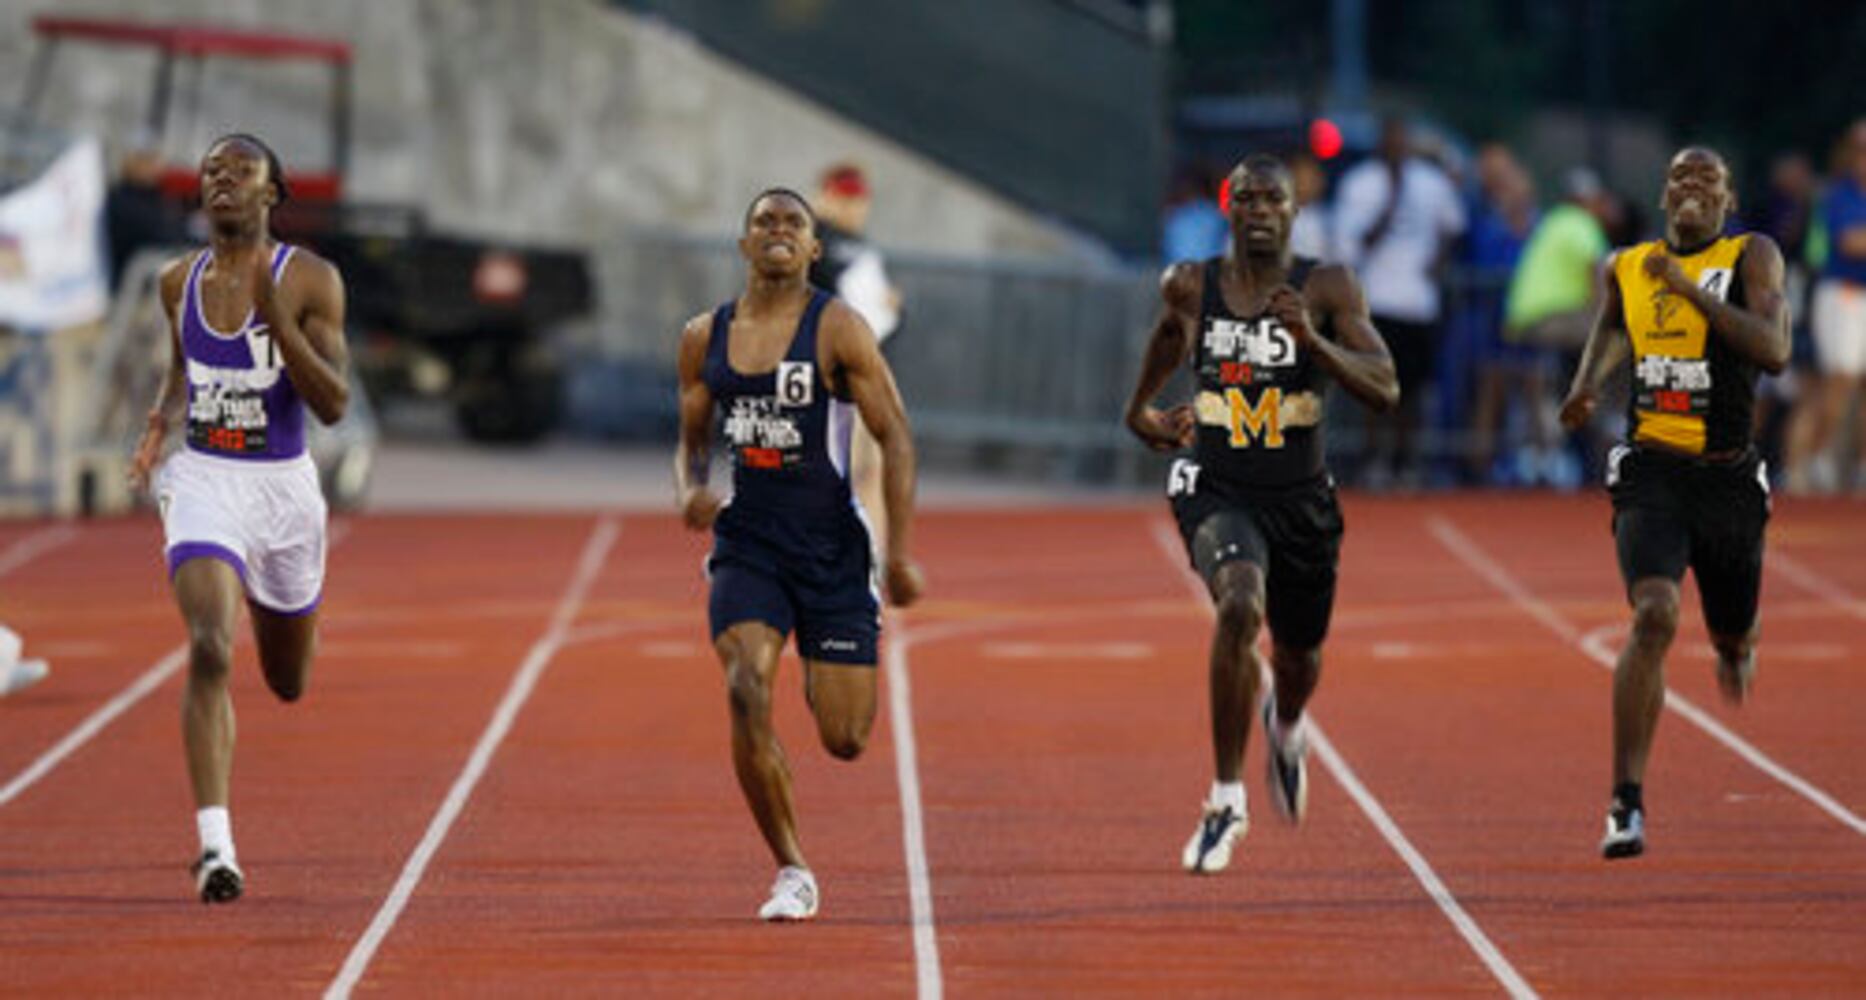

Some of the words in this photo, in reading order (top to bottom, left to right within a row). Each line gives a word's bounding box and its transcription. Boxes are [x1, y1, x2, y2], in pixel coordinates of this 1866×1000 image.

[1268, 324, 1288, 363] 5
[785, 364, 806, 403] 6
[1224, 387, 1284, 448] M
